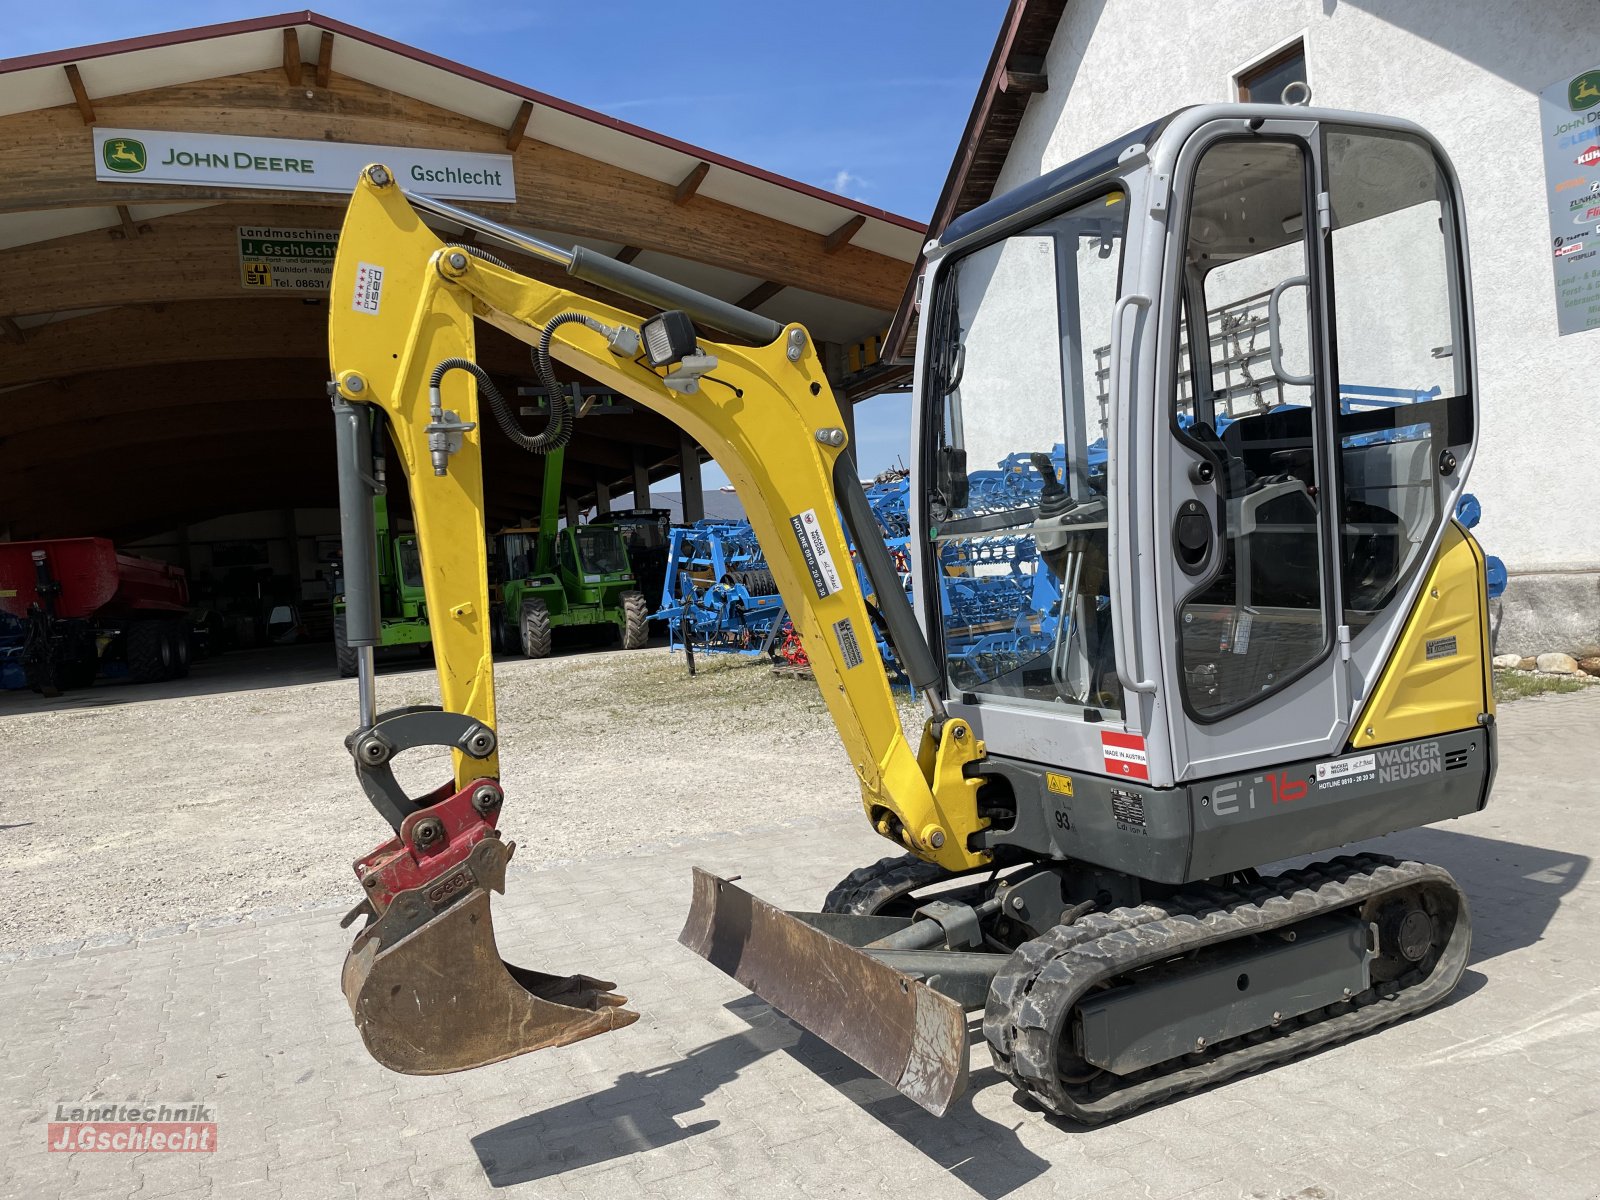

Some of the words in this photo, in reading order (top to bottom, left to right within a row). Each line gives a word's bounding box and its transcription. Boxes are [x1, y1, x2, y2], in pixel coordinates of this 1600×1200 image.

[161, 147, 230, 168] JOHN
[234, 152, 315, 174] DEERE
[411, 165, 502, 186] Gschlecht
[240, 227, 340, 240] Landmaschinen
[273, 279, 293, 288] Tel.
[370, 270, 382, 311] used
[792, 518, 809, 549] HOTLINE
[810, 531, 823, 556] NEUSON
[814, 529, 825, 554] WACKER
[1104, 749, 1118, 757] MADE
[1125, 753, 1146, 761] AUSTRIA
[1376, 742, 1440, 767] WACKER
[1378, 757, 1442, 783] NEUSON
[1318, 779, 1341, 790] HOTLINE
[1055, 810, 1070, 830] 93
[1142, 828, 1148, 836] A
